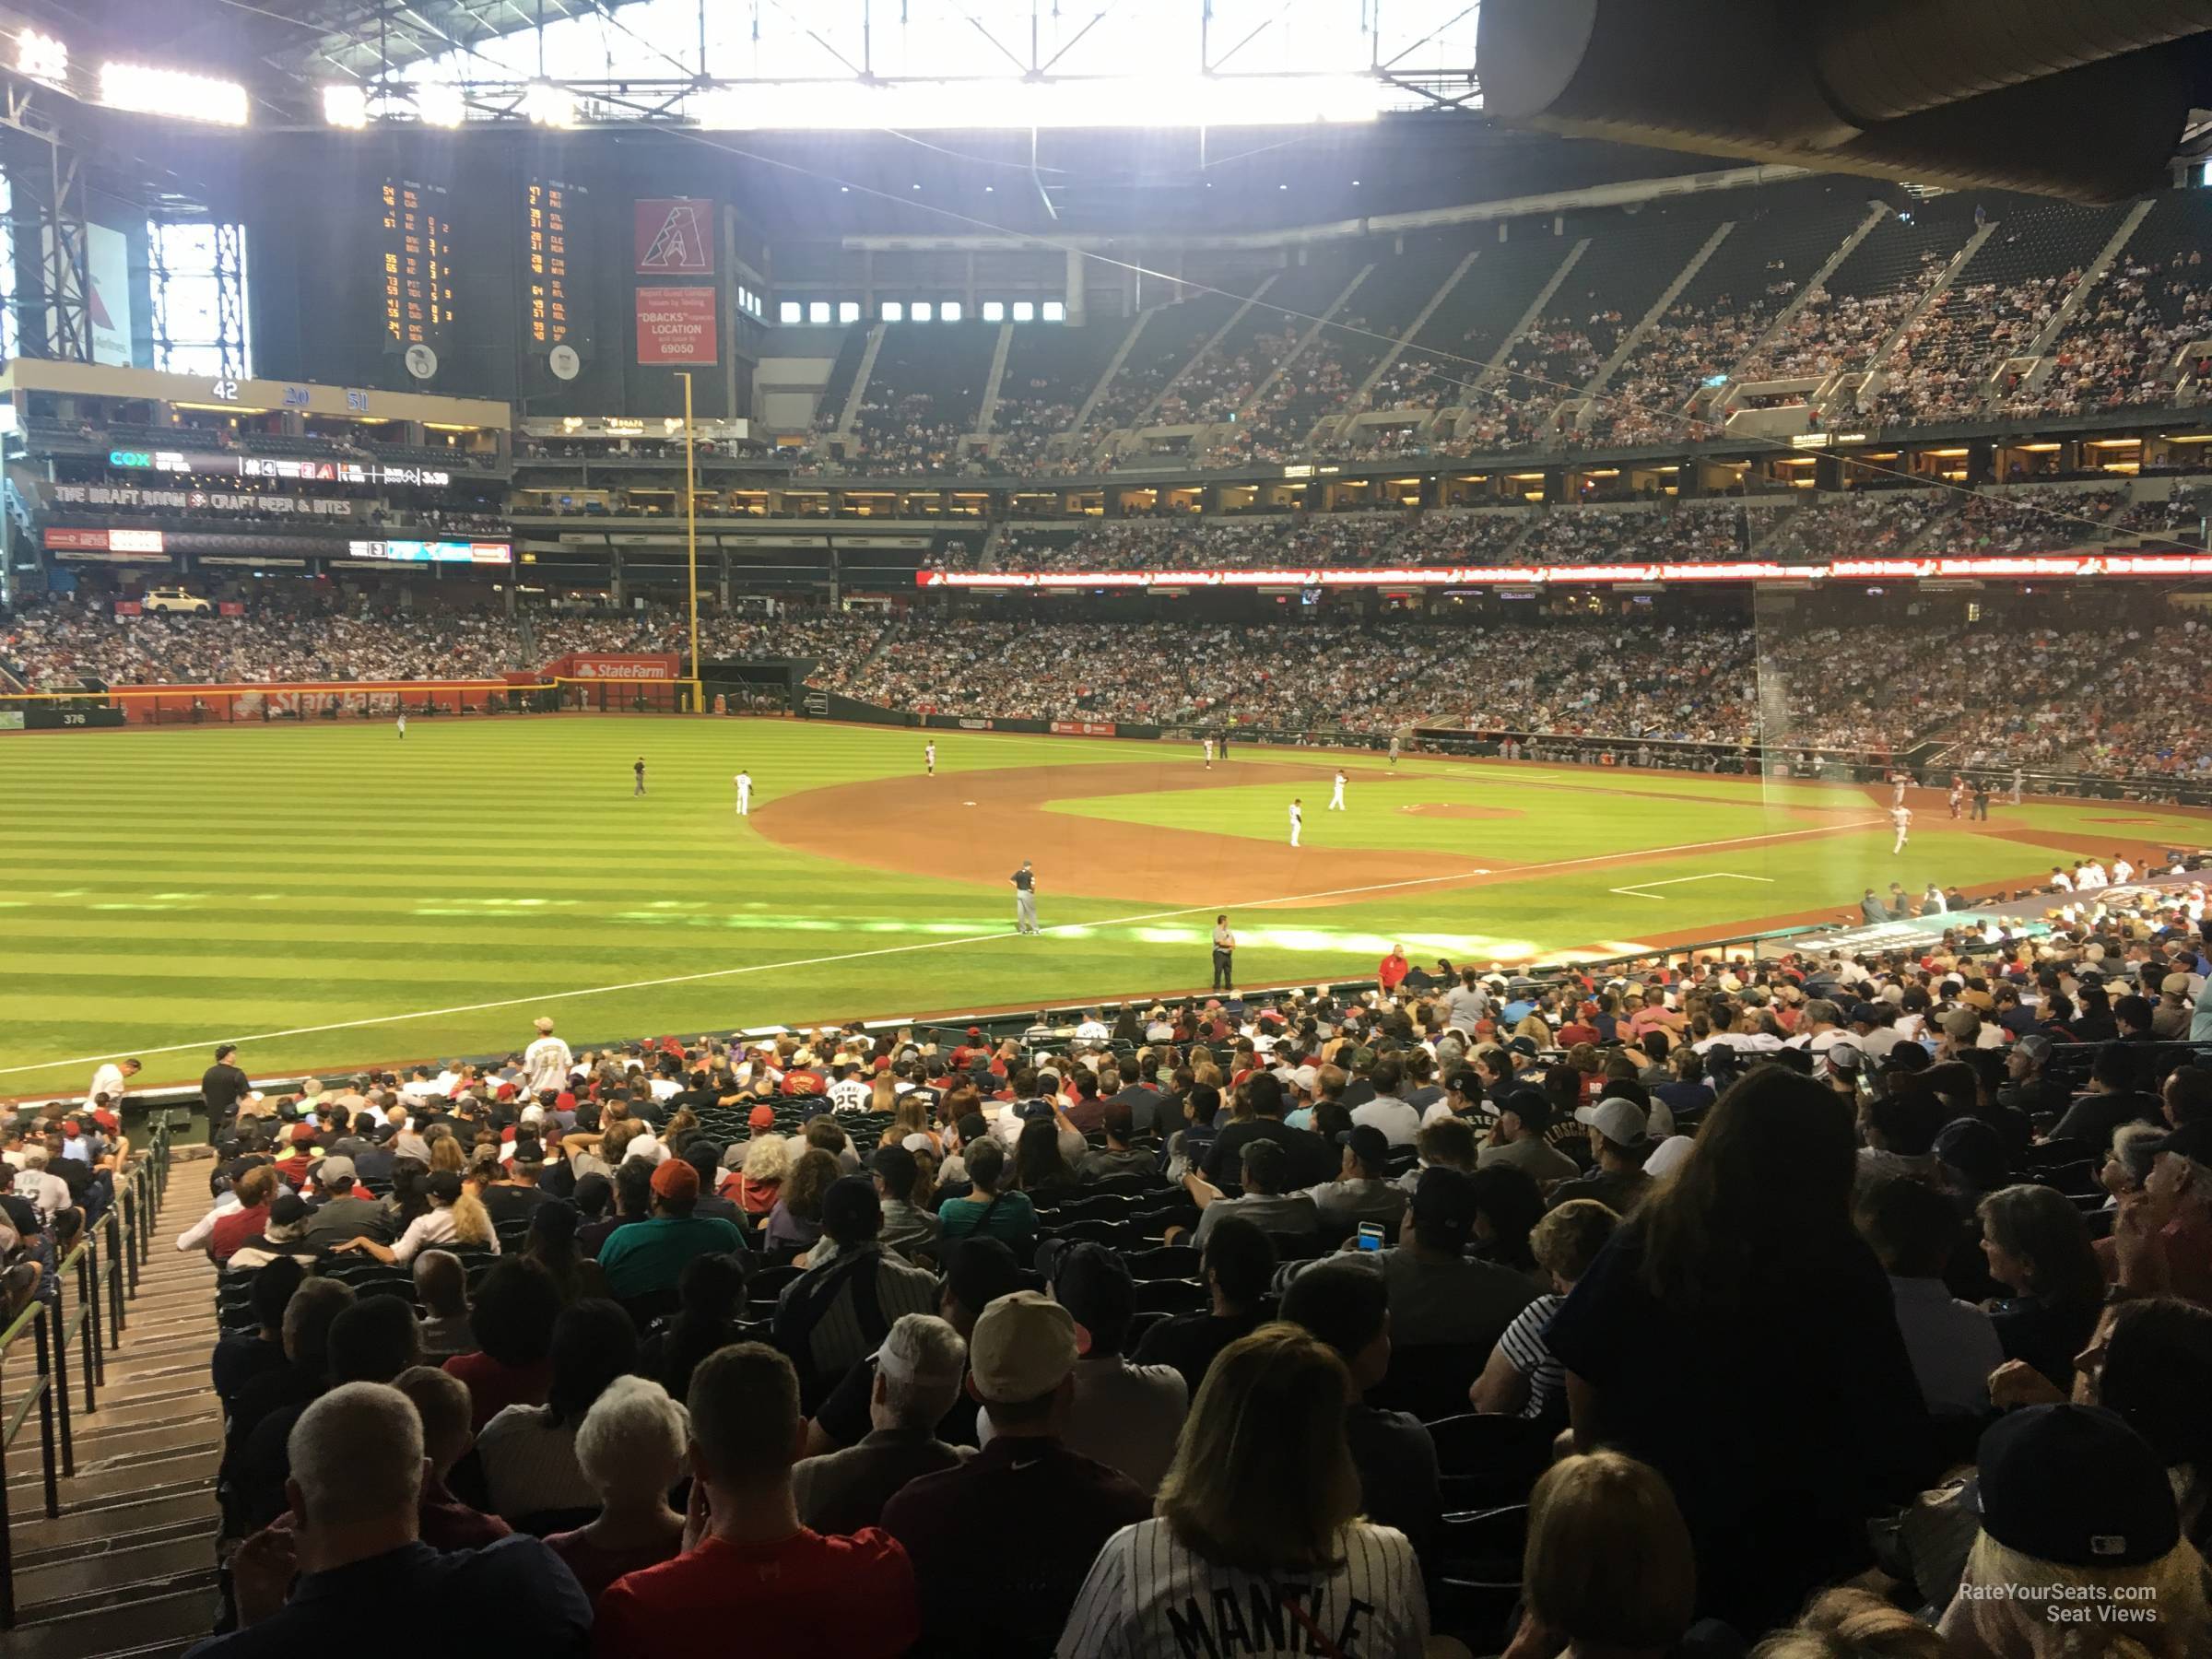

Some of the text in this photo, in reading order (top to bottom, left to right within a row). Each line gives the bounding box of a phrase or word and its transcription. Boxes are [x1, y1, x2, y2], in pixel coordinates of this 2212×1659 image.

[651, 324, 701, 334] LOCATION
[661, 344, 694, 354] 69050
[213, 381, 238, 400] 42
[283, 387, 310, 406] 20
[347, 392, 369, 412] 51
[110, 452, 150, 467] COX
[56, 487, 351, 514] THE DRAFT ROOM CRAFT BEER & BITES
[598, 664, 665, 679] State Farm
[64, 713, 86, 724] 376
[836, 1094, 858, 1110] 25
[1166, 1583, 1375, 1659] MANTLE
